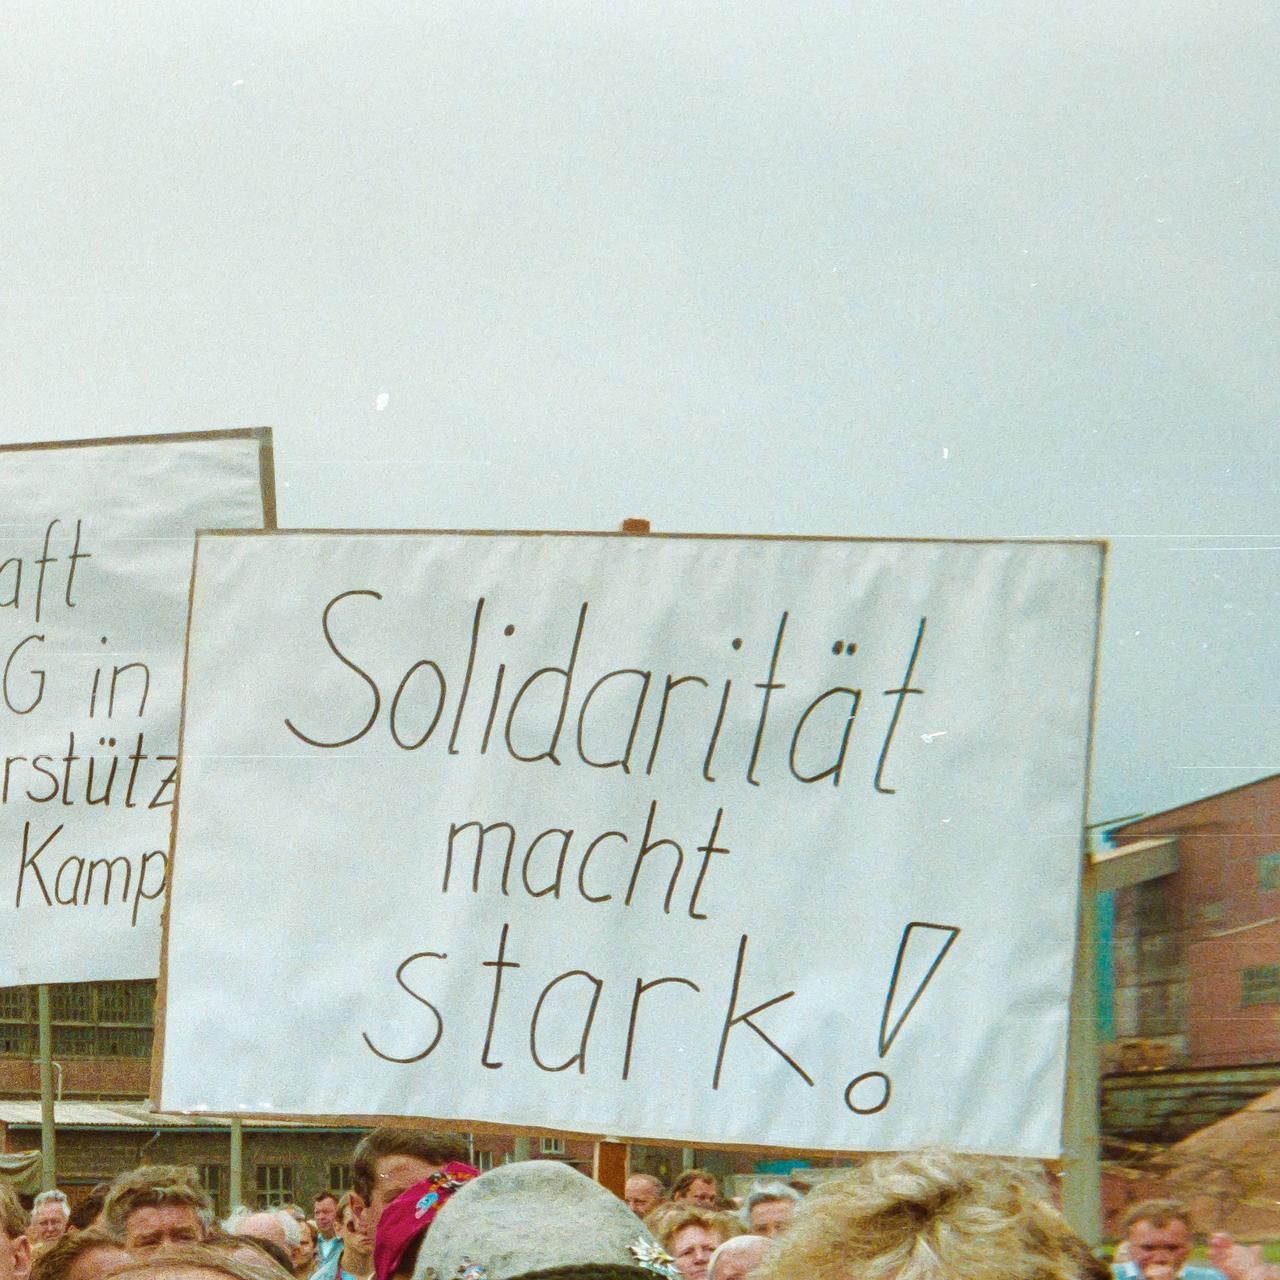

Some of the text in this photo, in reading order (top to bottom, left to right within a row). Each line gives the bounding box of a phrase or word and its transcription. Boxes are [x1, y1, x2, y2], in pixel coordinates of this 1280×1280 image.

[89, 636, 151, 719] in
[285, 589, 925, 795] Solidarität
[15, 822, 169, 927] Kamp
[442, 800, 730, 920] macht
[362, 922, 962, 1116] stark!
